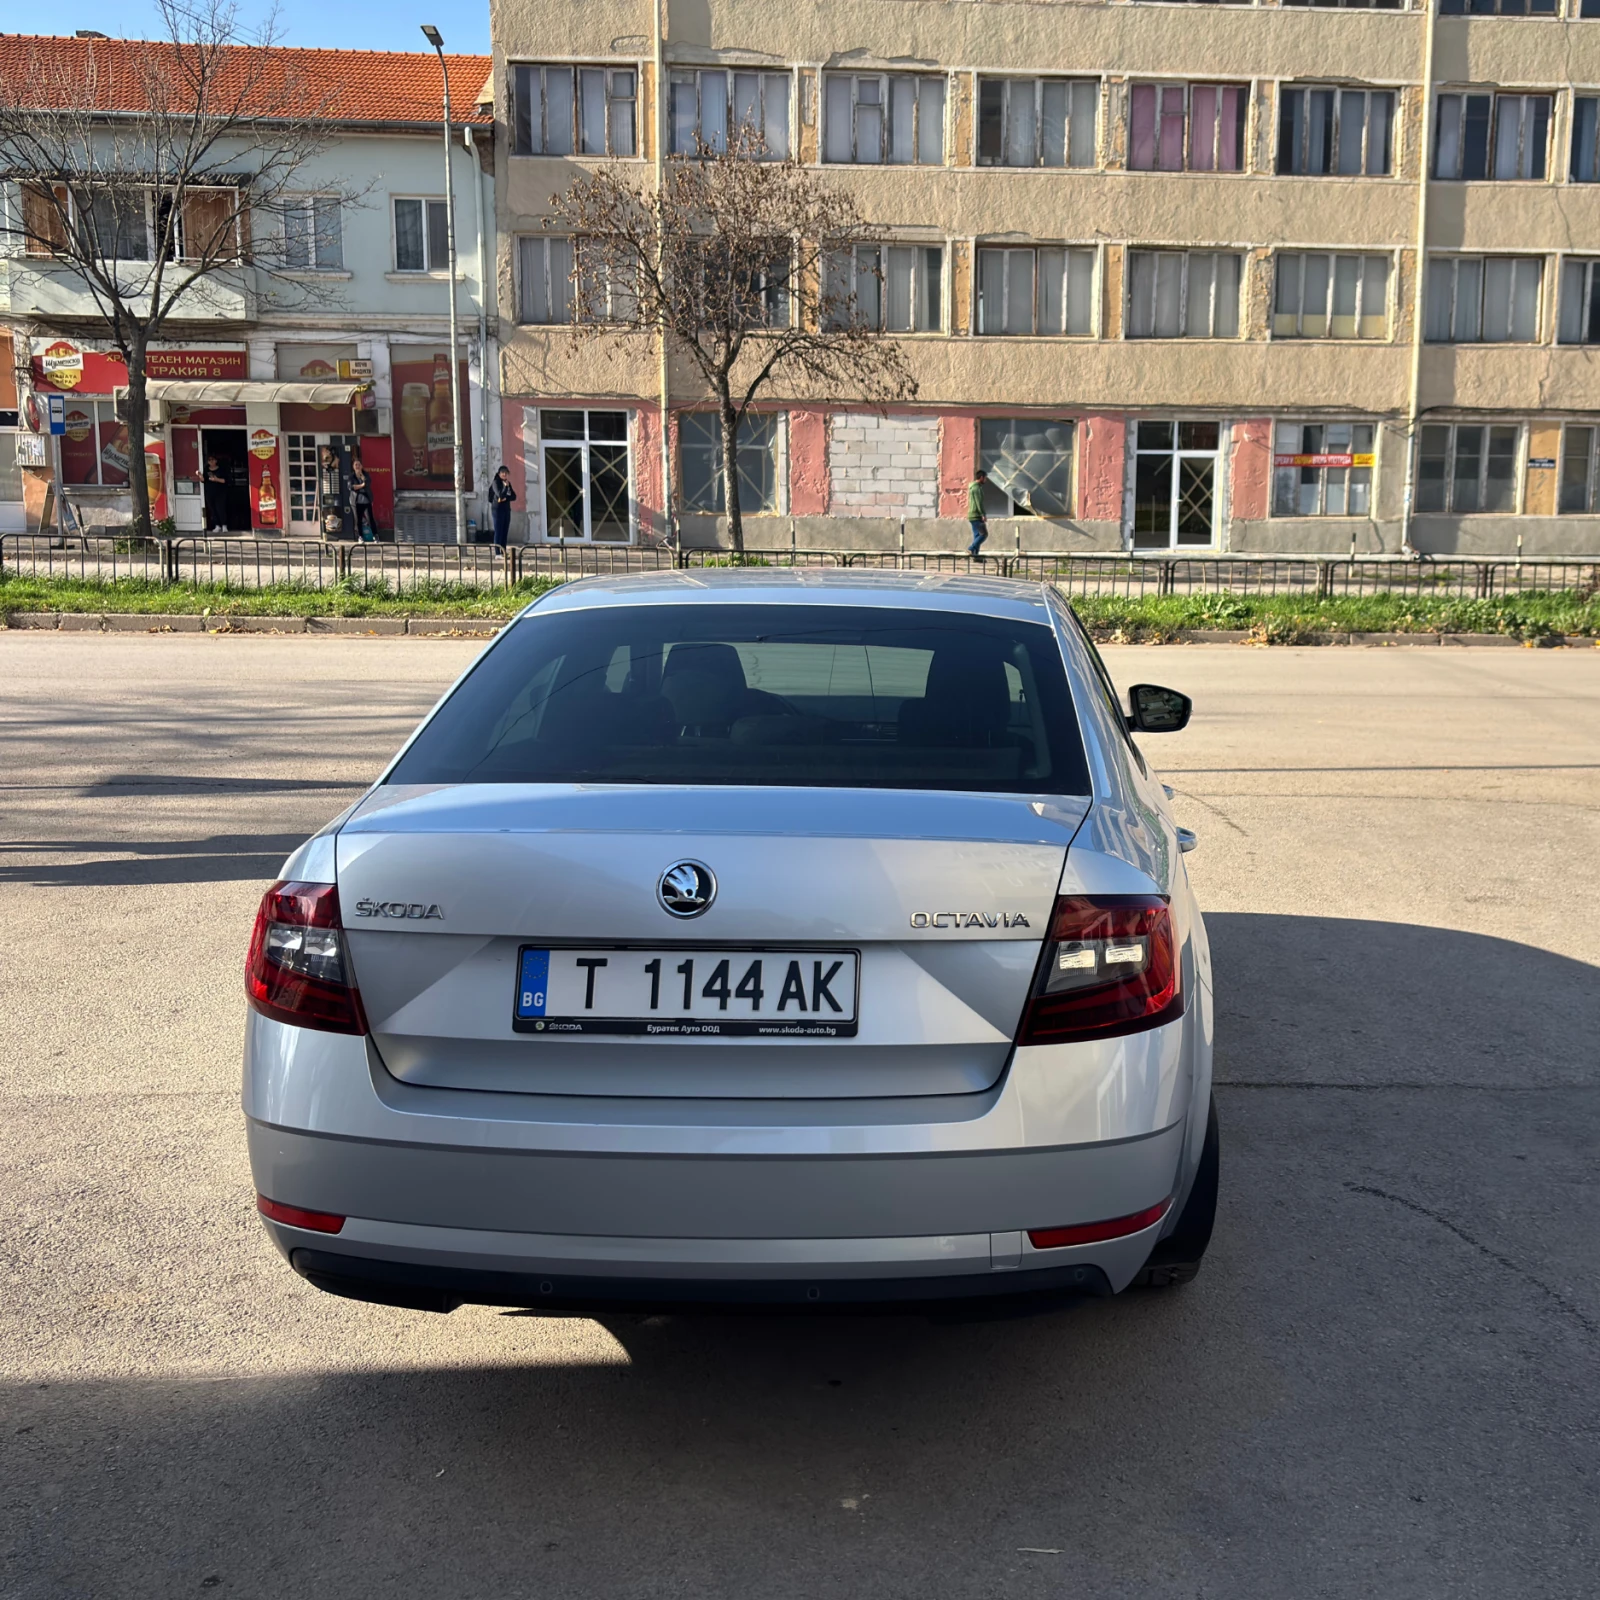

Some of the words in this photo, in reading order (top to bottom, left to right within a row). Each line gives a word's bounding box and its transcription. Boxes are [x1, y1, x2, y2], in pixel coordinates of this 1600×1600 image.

[185, 356, 241, 365] МАГАЗИН
[151, 366, 207, 376] ТРАКИЯ
[212, 368, 222, 377] 8
[355, 897, 444, 920] ŠKODA
[910, 912, 1031, 929] OCTAVIA
[576, 958, 608, 1009] T
[644, 958, 764, 1011] 1144
[777, 960, 844, 1012] AK
[522, 992, 544, 1007] BG
[680, 1025, 700, 1034] Ауто
[702, 1025, 720, 1034] ООД
[759, 1026, 837, 1036] www.skoda-auto.bg
